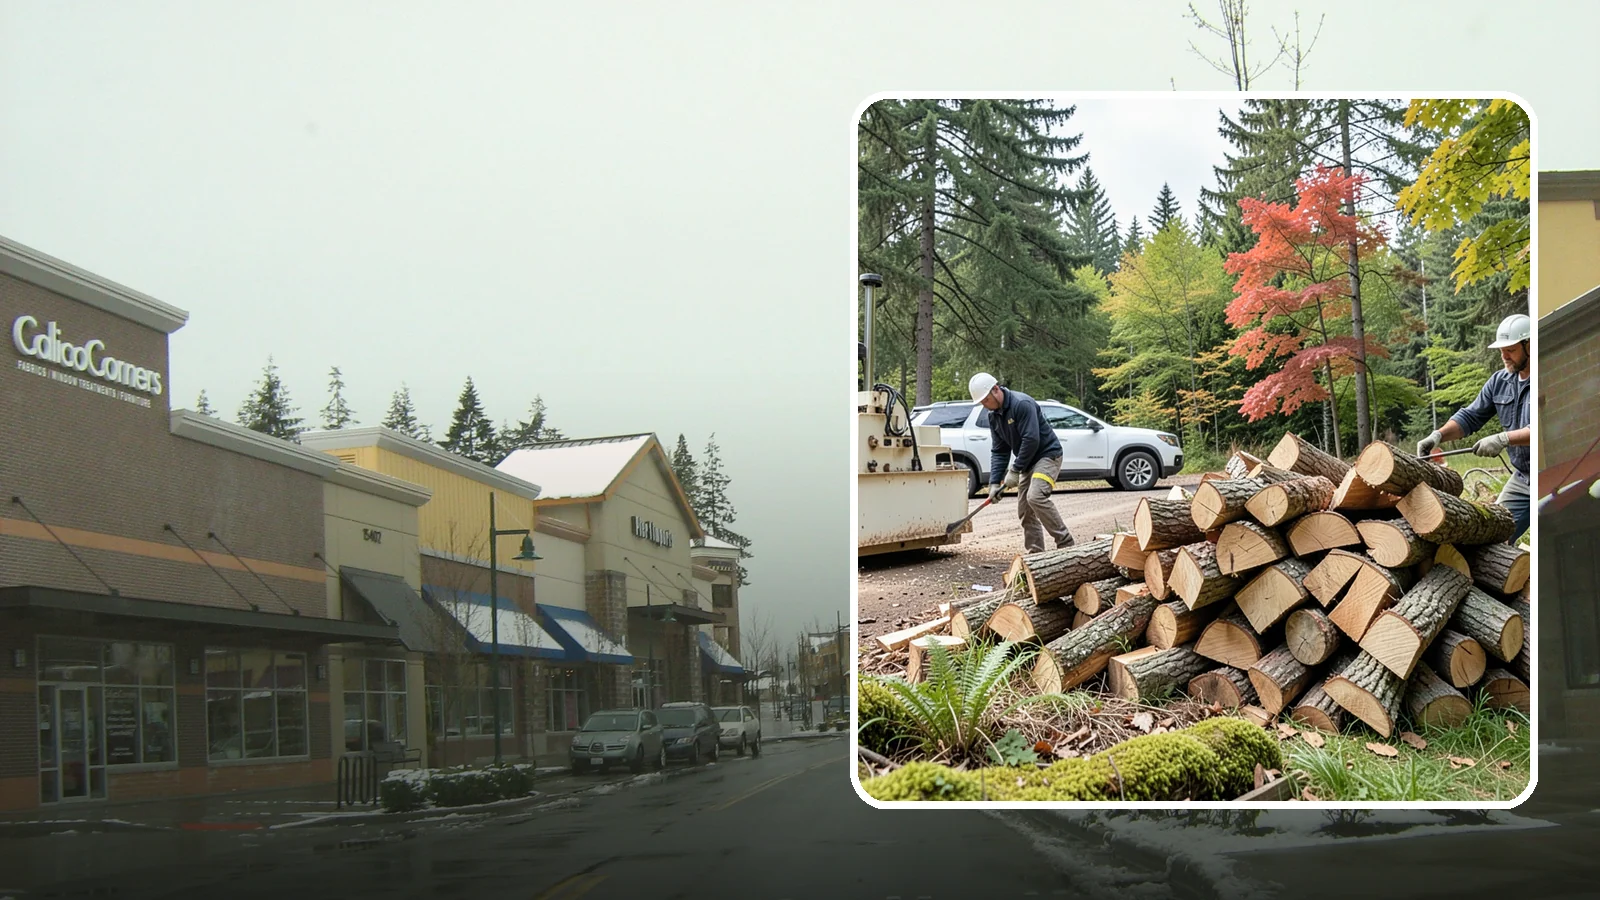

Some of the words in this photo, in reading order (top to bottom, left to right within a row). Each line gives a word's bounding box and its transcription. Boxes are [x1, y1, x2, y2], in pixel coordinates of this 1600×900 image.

[17, 360, 47, 378] FABRICS
[51, 370, 78, 387] WINDOW
[79, 378, 117, 398] TREATMENTS
